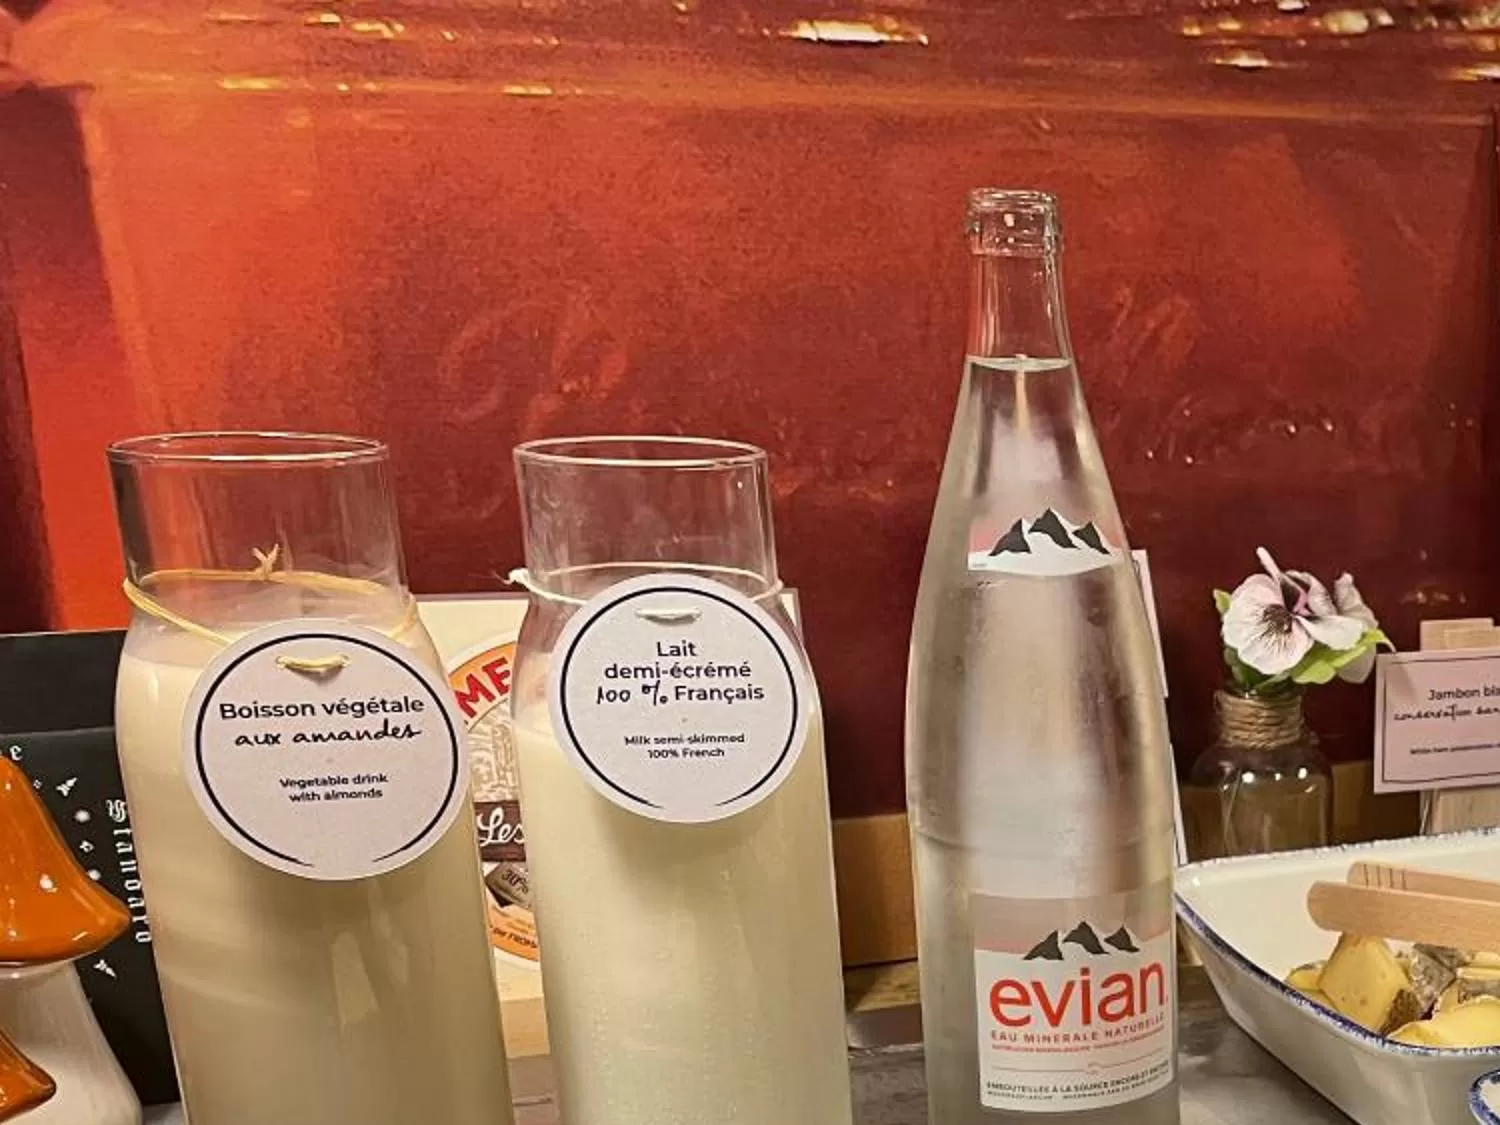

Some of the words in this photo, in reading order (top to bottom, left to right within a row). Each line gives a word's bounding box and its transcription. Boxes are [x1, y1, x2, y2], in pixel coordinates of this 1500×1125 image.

[656, 640, 697, 657] Lait
[604, 661, 751, 679] demi-écrémé
[675, 683, 765, 704] Français
[1428, 688, 1480, 701] Jambon
[219, 700, 315, 720] Boisson
[322, 696, 425, 719] végétale
[234, 731, 281, 747] aux
[293, 719, 421, 744] amandes
[624, 735, 651, 746] Milk
[653, 733, 745, 746] semi-skimmed
[648, 748, 679, 759] 100%
[682, 747, 725, 758] French
[279, 775, 349, 790] Vegetable
[352, 773, 389, 786] drink
[289, 790, 321, 802] with
[323, 788, 383, 801] almonds
[989, 961, 1166, 1028] evian
[990, 1030, 1017, 1042] EAU
